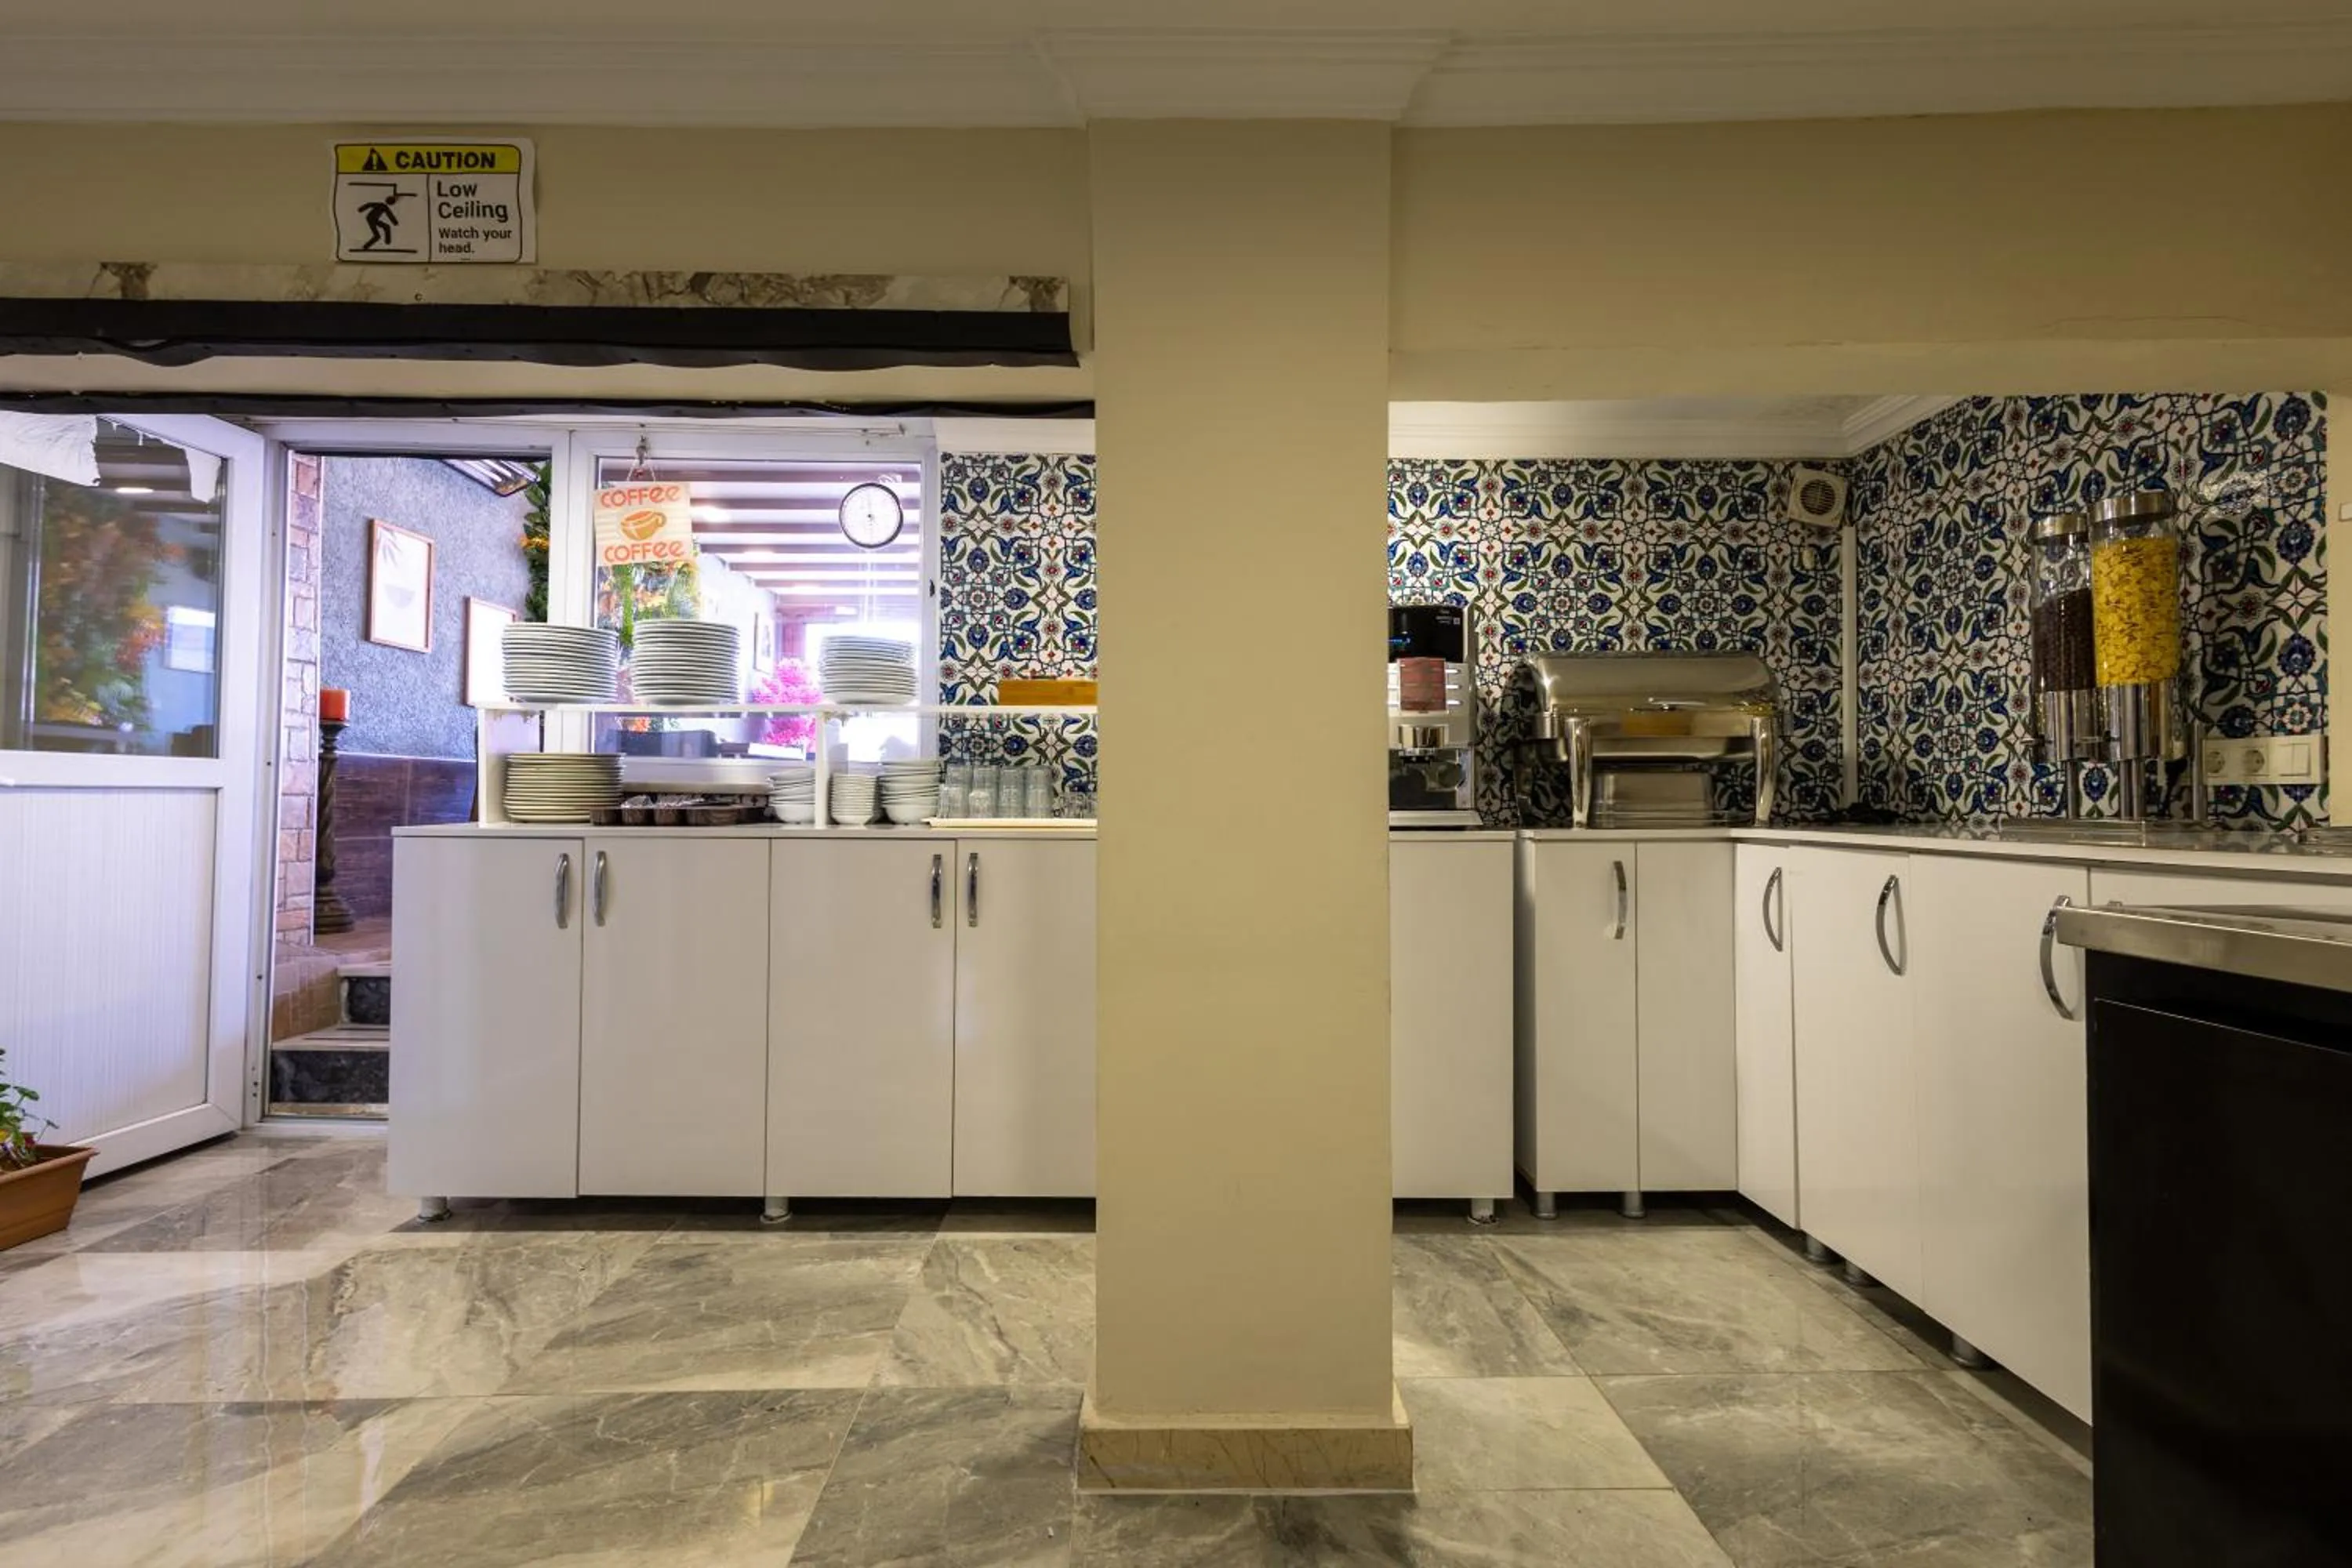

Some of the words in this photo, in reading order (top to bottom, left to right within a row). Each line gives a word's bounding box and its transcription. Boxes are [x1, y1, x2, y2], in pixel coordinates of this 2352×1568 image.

[395, 151, 495, 169] CAUTION
[437, 180, 477, 198] Low
[438, 201, 508, 223] Ceiling
[438, 227, 479, 239] Watch
[482, 228, 512, 241] your
[439, 242, 474, 253] head.
